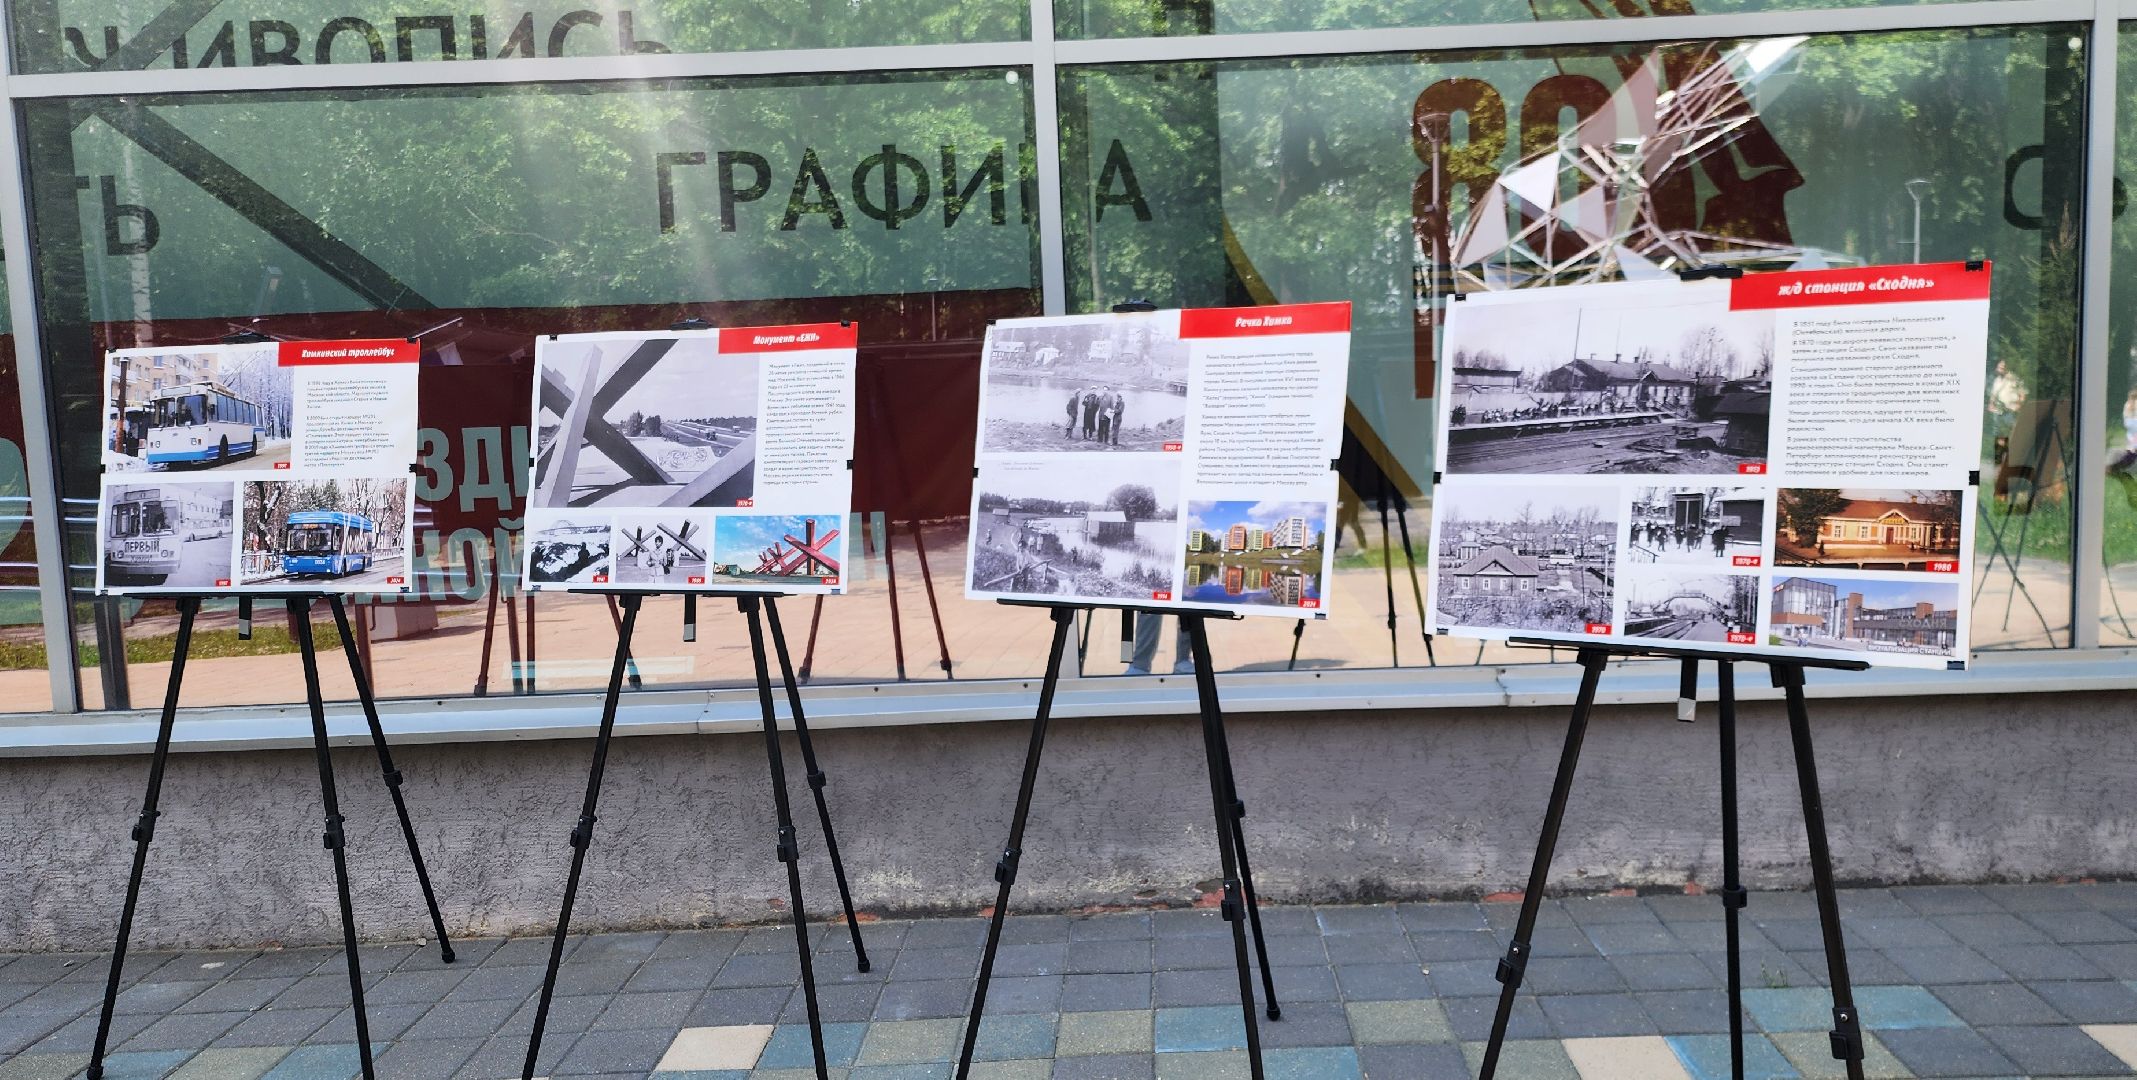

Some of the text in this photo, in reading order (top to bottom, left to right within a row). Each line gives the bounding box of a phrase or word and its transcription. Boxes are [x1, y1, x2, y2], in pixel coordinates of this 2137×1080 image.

[1868, 276, 1935, 292] «Сходня»
[124, 539, 160, 553] ПЕРВЫЙ
[1933, 562, 1952, 572] 1980
